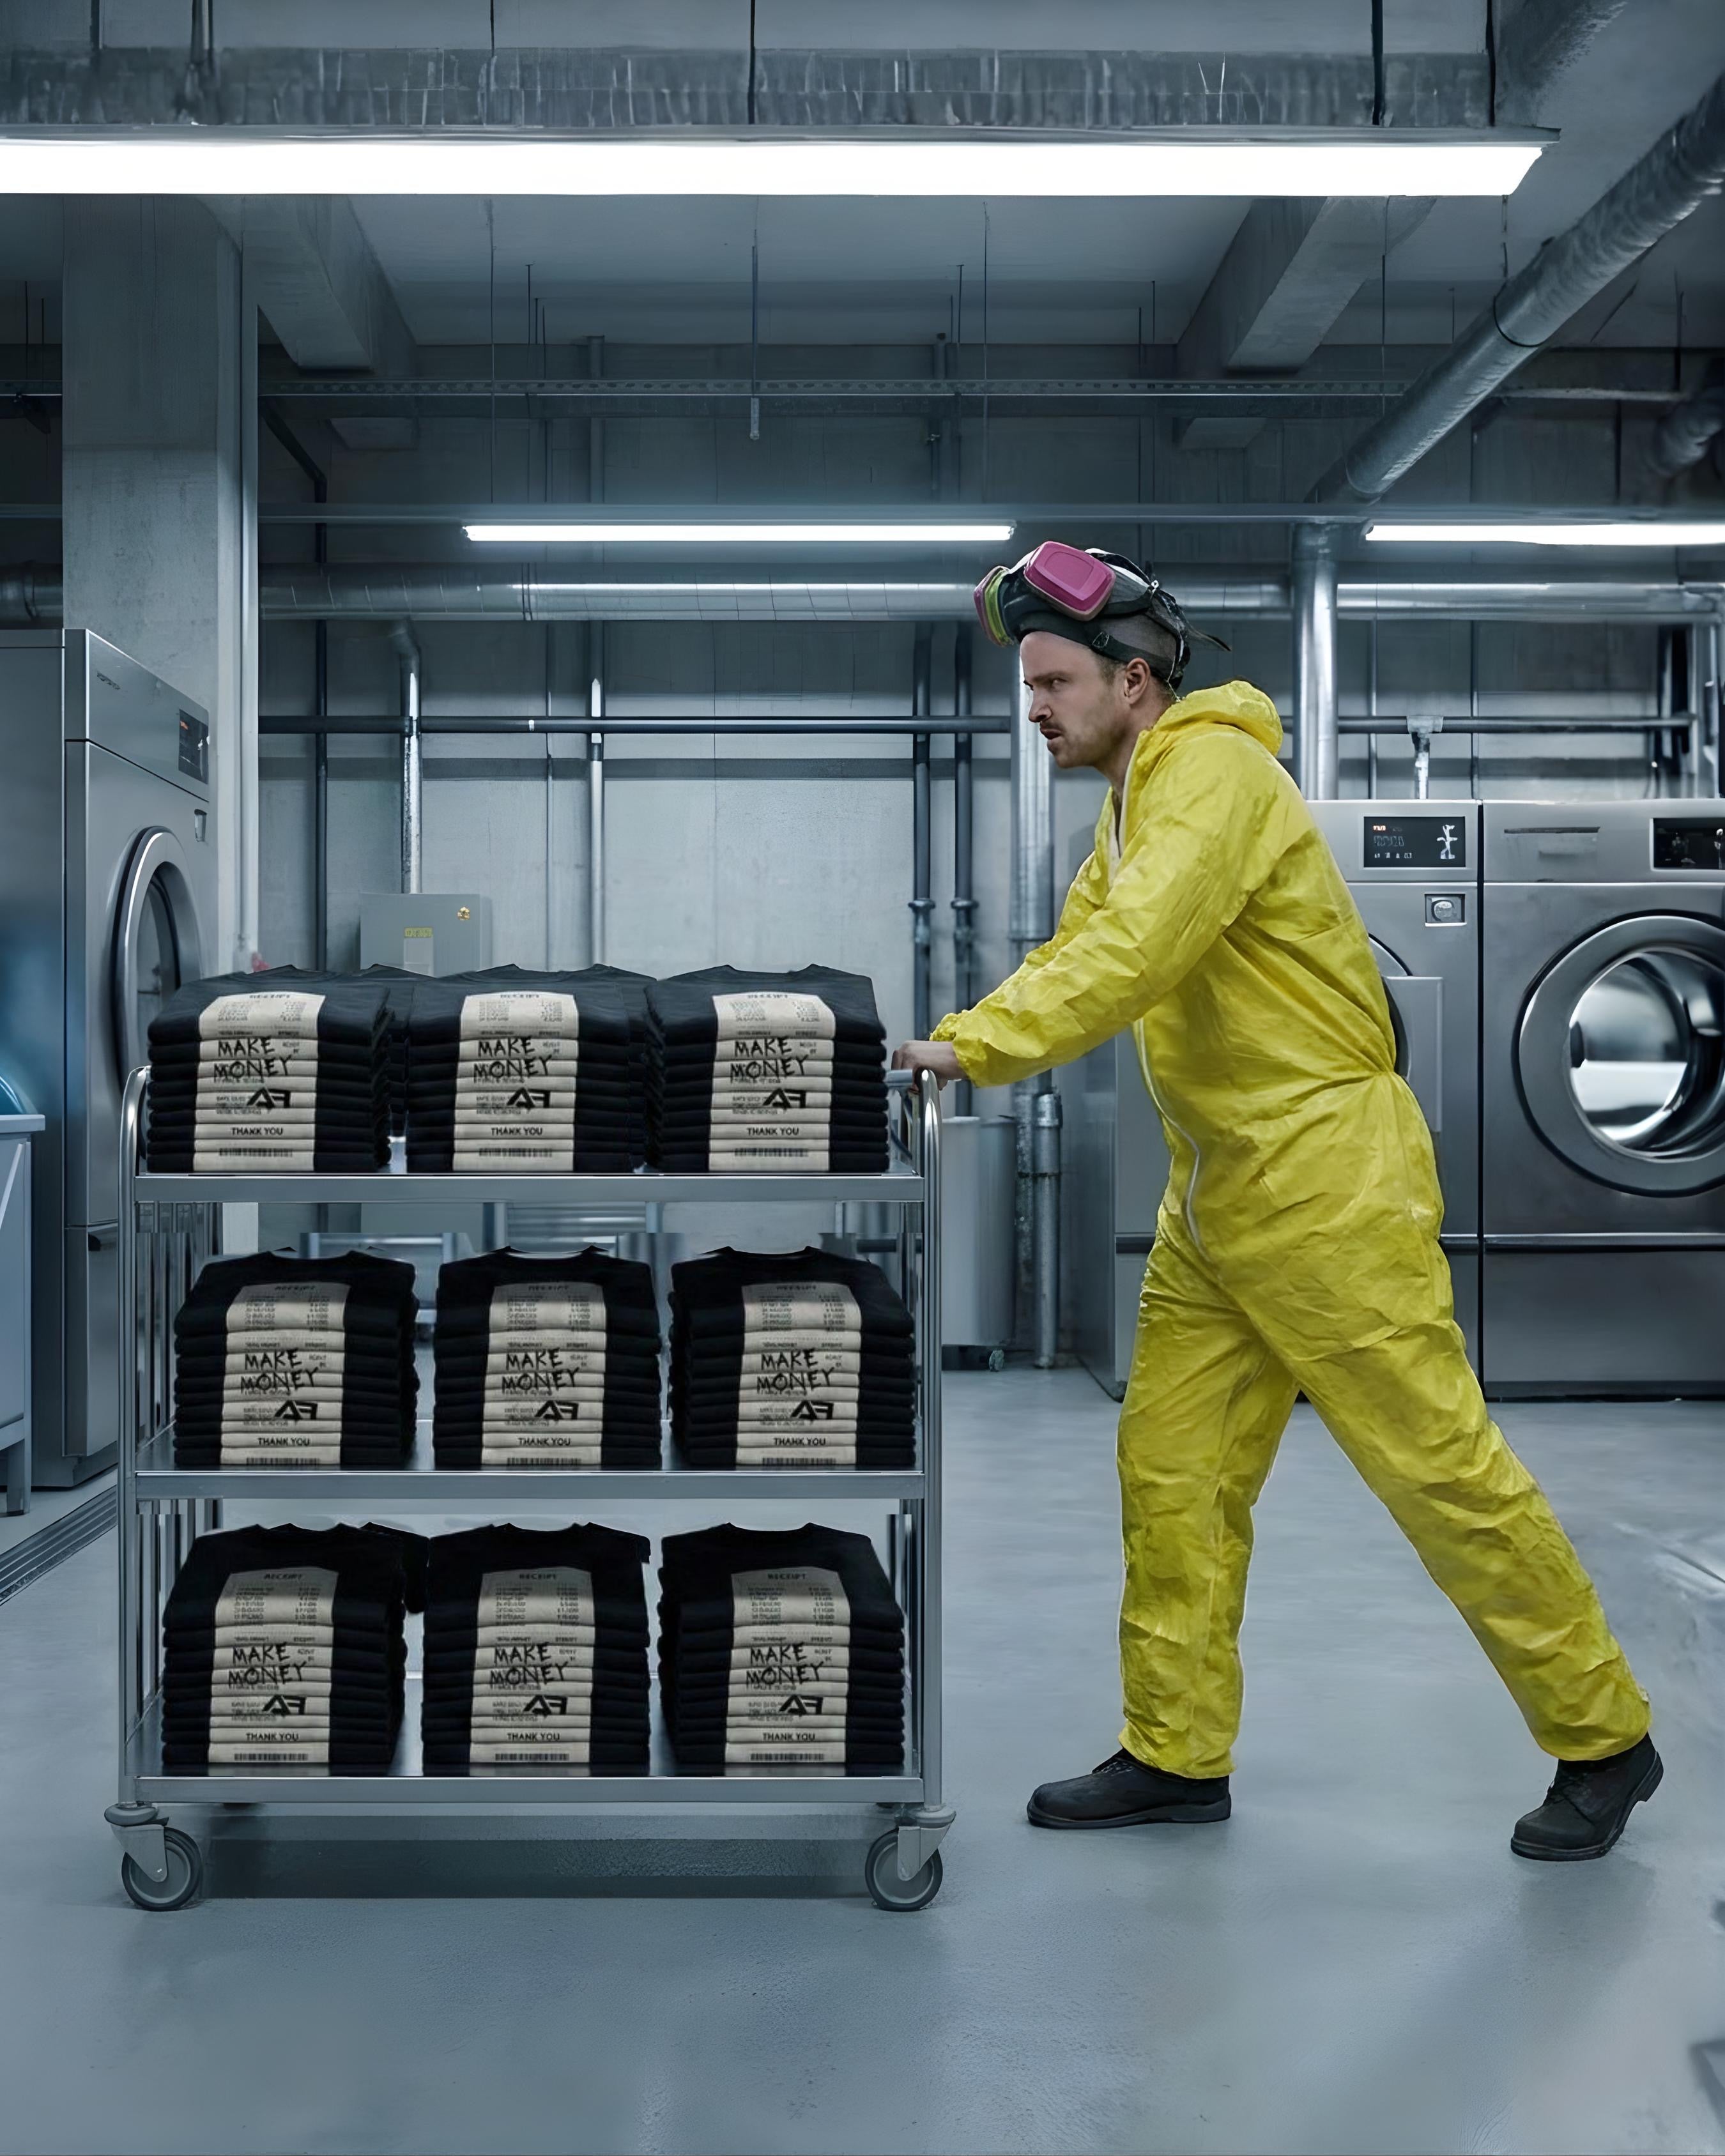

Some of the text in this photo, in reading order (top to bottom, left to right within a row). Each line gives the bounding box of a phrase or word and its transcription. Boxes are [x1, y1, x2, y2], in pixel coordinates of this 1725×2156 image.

[218, 1036, 276, 1058] MAKE
[478, 1036, 535, 1057] MAKE
[735, 1036, 792, 1057] MAKE
[213, 1055, 294, 1083] MONEY
[473, 1055, 552, 1082] MONEY
[730, 1055, 809, 1083] MONEY
[245, 1348, 302, 1370] MAKE
[506, 1348, 564, 1370] MAKE
[761, 1348, 818, 1370] MAKE
[241, 1367, 319, 1394] MONEY
[502, 1367, 579, 1394] MONEY
[757, 1367, 834, 1394] MONEY
[233, 1642, 291, 1664] MAKE
[494, 1642, 552, 1664] MAKE
[750, 1642, 808, 1664] MAKE
[229, 1662, 308, 1689] MONEY
[490, 1662, 569, 1689] MONEY
[746, 1662, 824, 1689] MONEY
